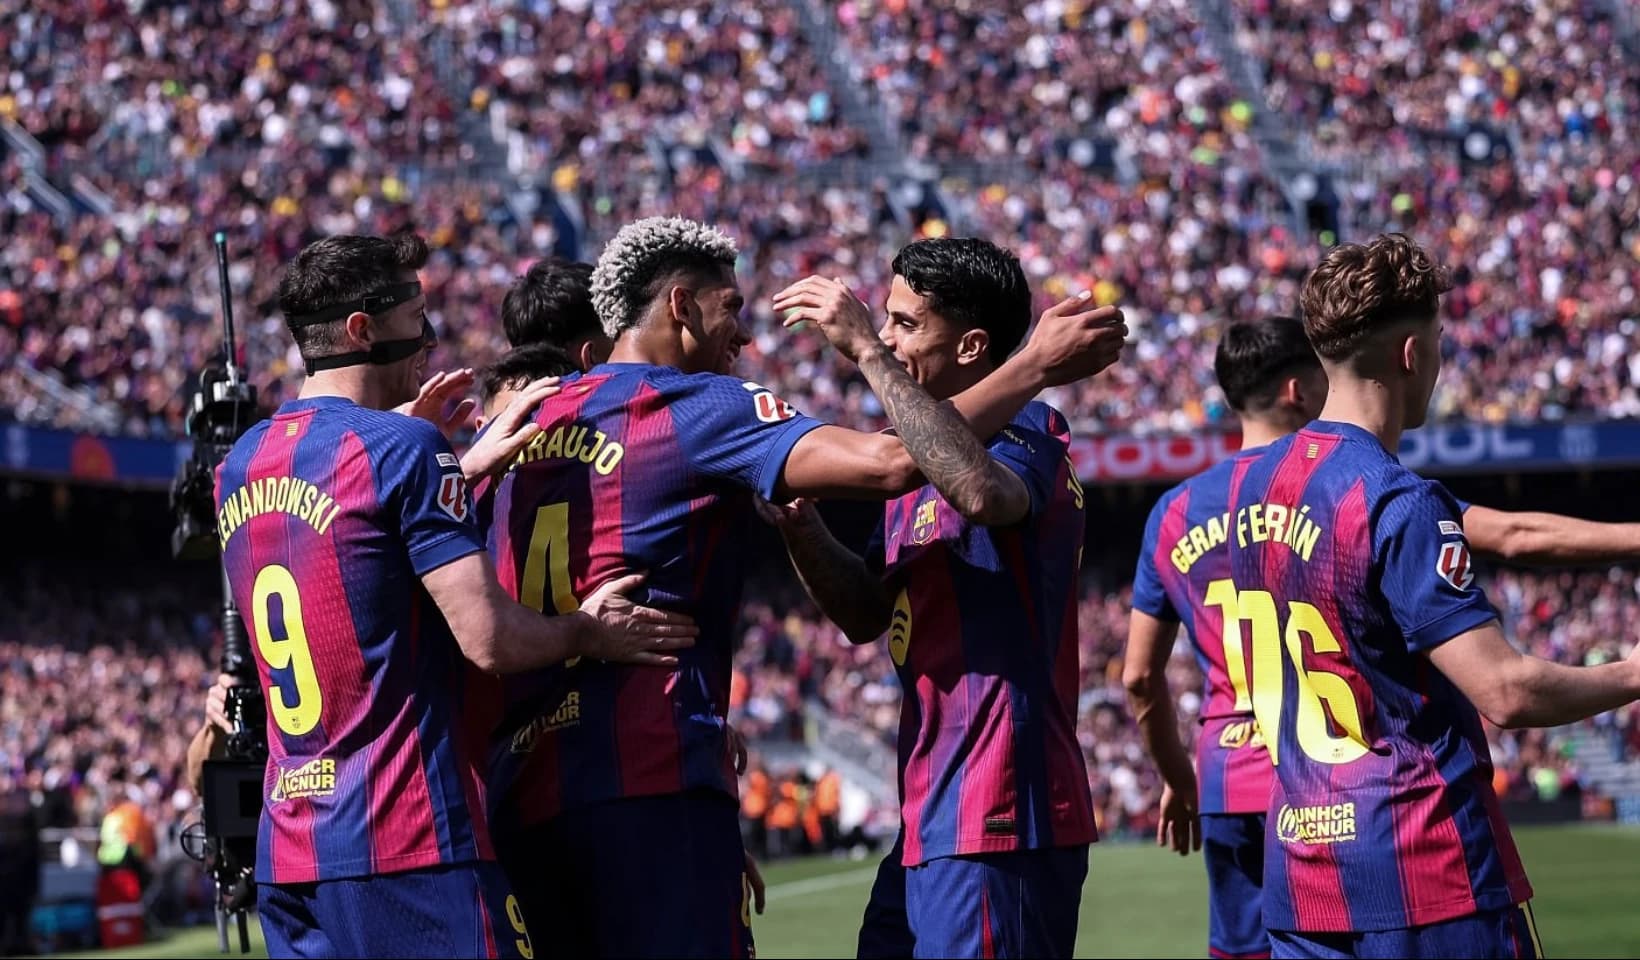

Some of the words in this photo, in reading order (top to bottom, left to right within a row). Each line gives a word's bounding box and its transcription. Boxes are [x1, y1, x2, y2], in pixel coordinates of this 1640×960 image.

[1171, 512, 1230, 574] GERA
[252, 564, 323, 735] 9
[1238, 590, 1370, 766] 16
[1295, 802, 1356, 823] UNHCR
[1299, 818, 1356, 839] ACNUR
